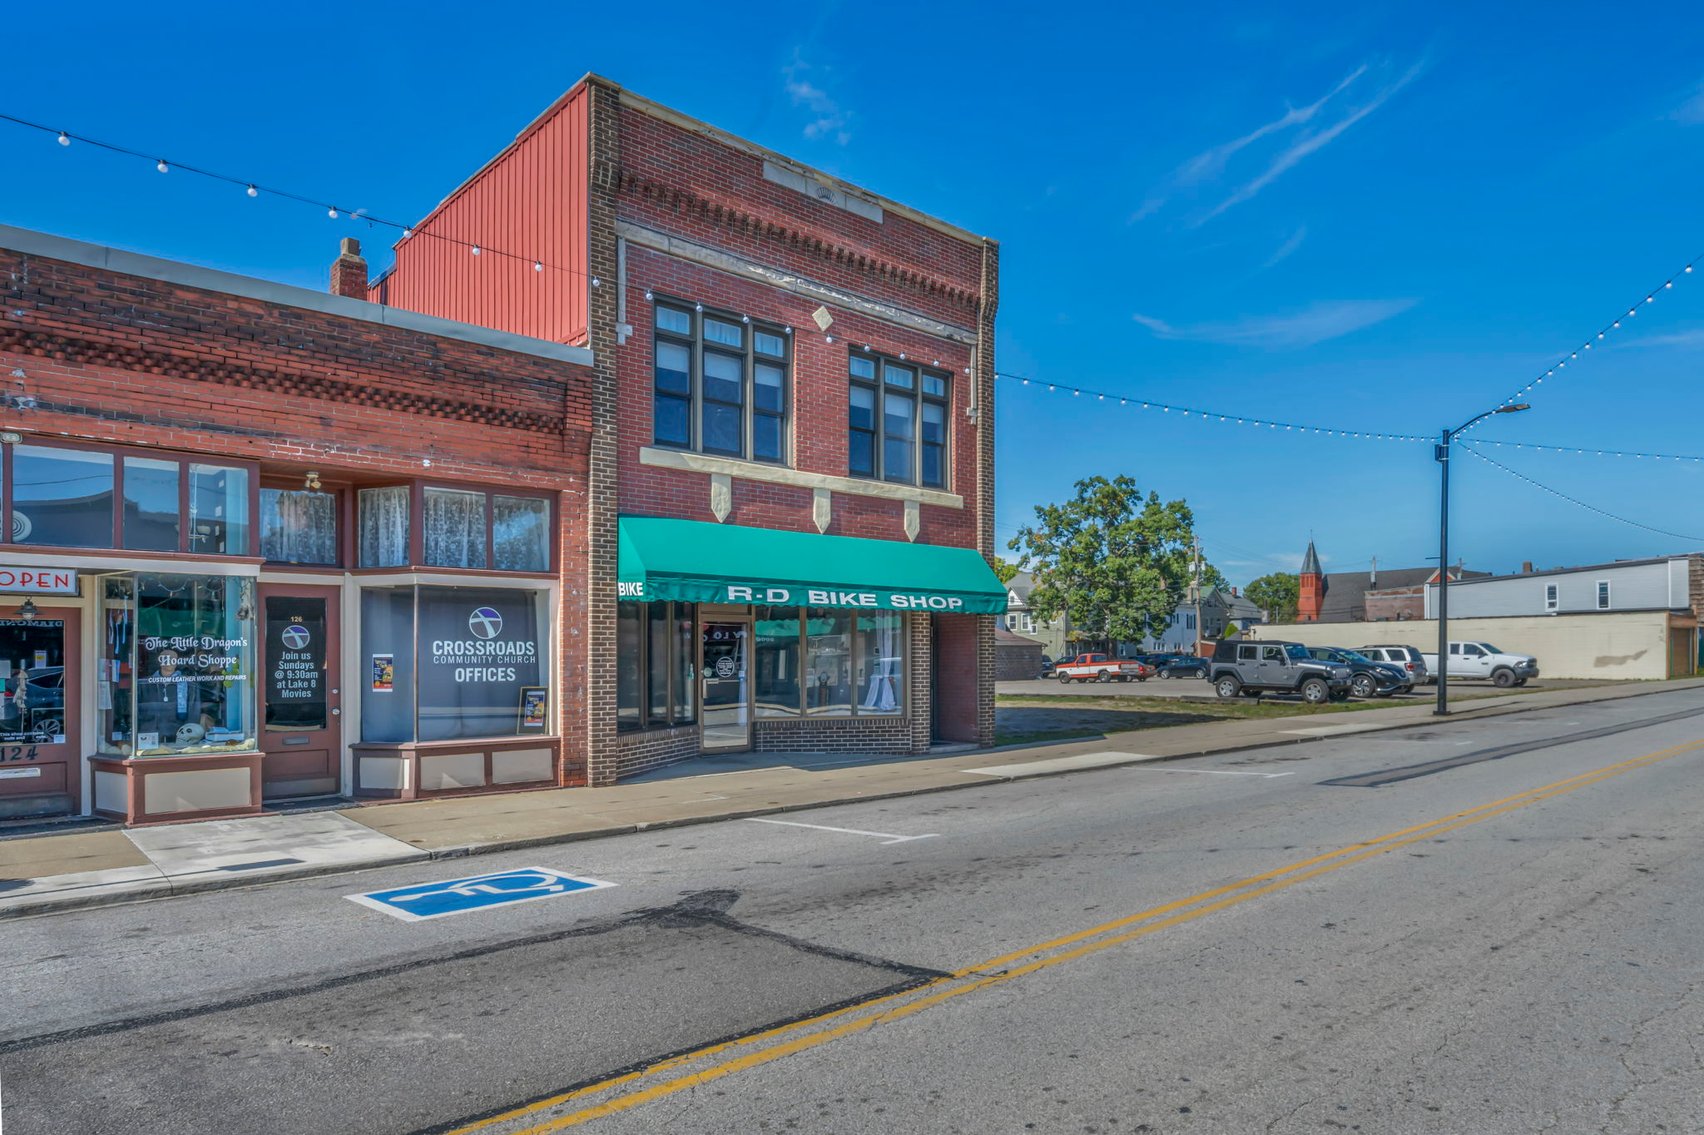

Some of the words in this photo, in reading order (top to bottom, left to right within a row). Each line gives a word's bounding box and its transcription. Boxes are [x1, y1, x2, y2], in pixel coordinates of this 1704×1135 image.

[0, 571, 69, 588] OPEN
[618, 582, 644, 596] BIKE
[727, 585, 790, 603] R-D
[808, 589, 878, 607] BIKE
[890, 594, 963, 609] SHOP
[145, 636, 168, 650] The
[170, 636, 199, 651] Little
[201, 636, 248, 651] Dragon's
[432, 640, 535, 655] CROSSROADS
[158, 654, 195, 666] Hoard
[198, 654, 237, 668] Shoppe
[281, 651, 299, 660] Join
[301, 652, 311, 660] us
[433, 655, 493, 664] COMMUNITY
[497, 656, 536, 664] CHURCH
[278, 661, 314, 671] Sundays
[274, 670, 285, 679] @
[287, 670, 318, 679] 9:30am
[455, 667, 516, 682] OFFICES
[276, 680, 286, 688] at
[288, 679, 308, 688] Lake
[310, 679, 317, 688] 8
[281, 689, 312, 698] Movies
[0, 745, 39, 762] 124
